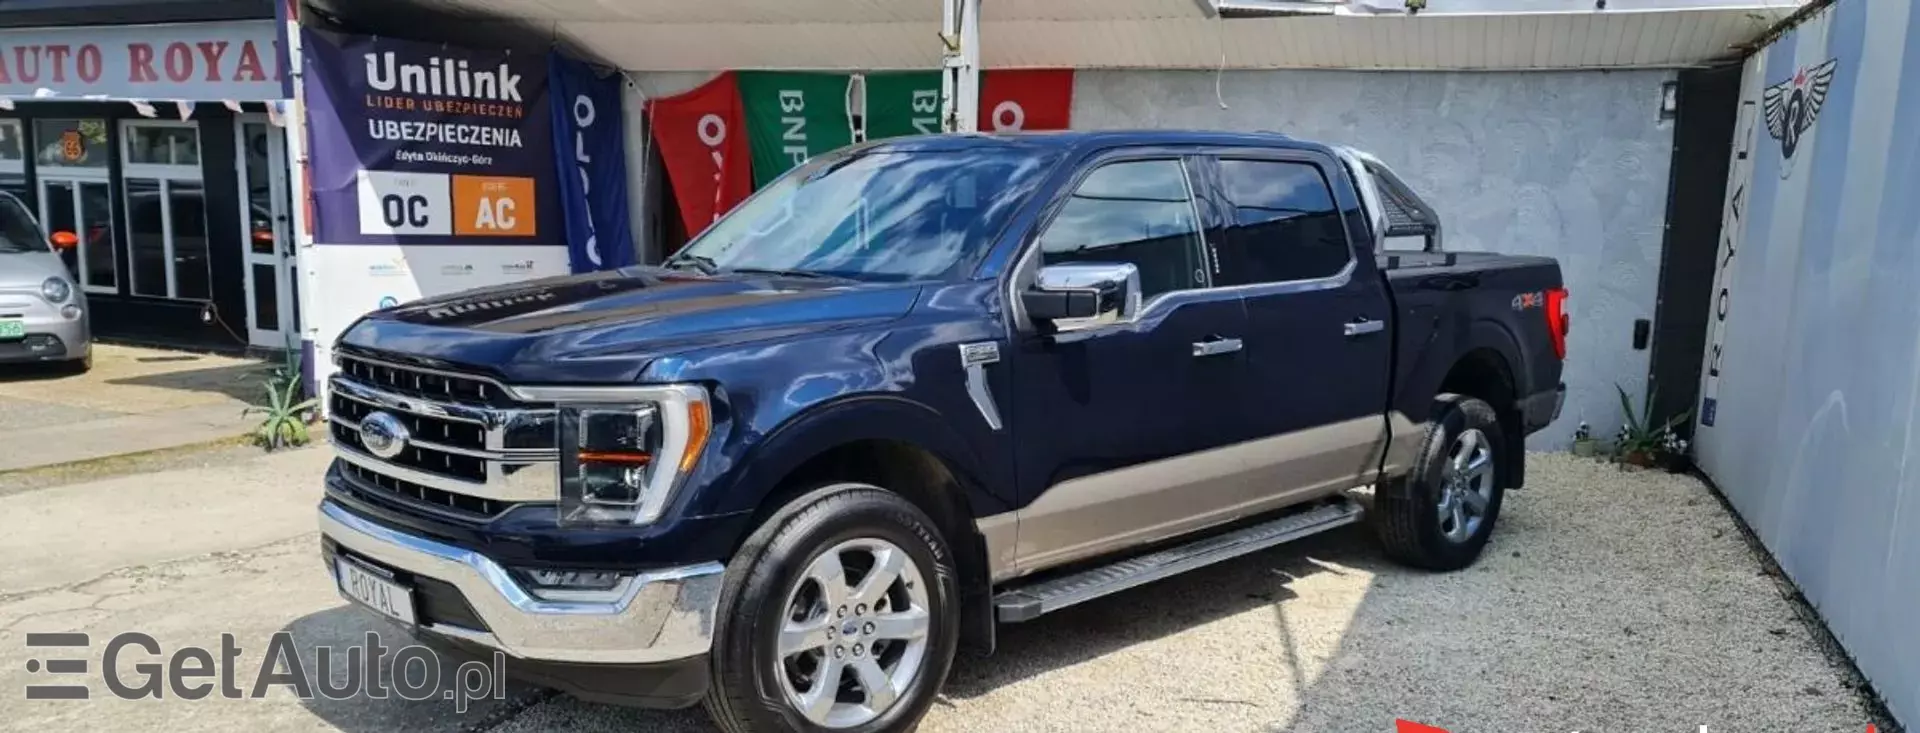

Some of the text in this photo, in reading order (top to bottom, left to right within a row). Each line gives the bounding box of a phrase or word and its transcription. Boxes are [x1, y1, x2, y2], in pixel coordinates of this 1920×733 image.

[364, 51, 522, 102] Unilink
[366, 94, 415, 110] LIDER
[368, 118, 523, 147] UBEZPIECZENIA
[395, 149, 424, 163] Edyta
[382, 194, 429, 228] OC
[475, 196, 516, 230] AC
[351, 570, 400, 617] ROYAL
